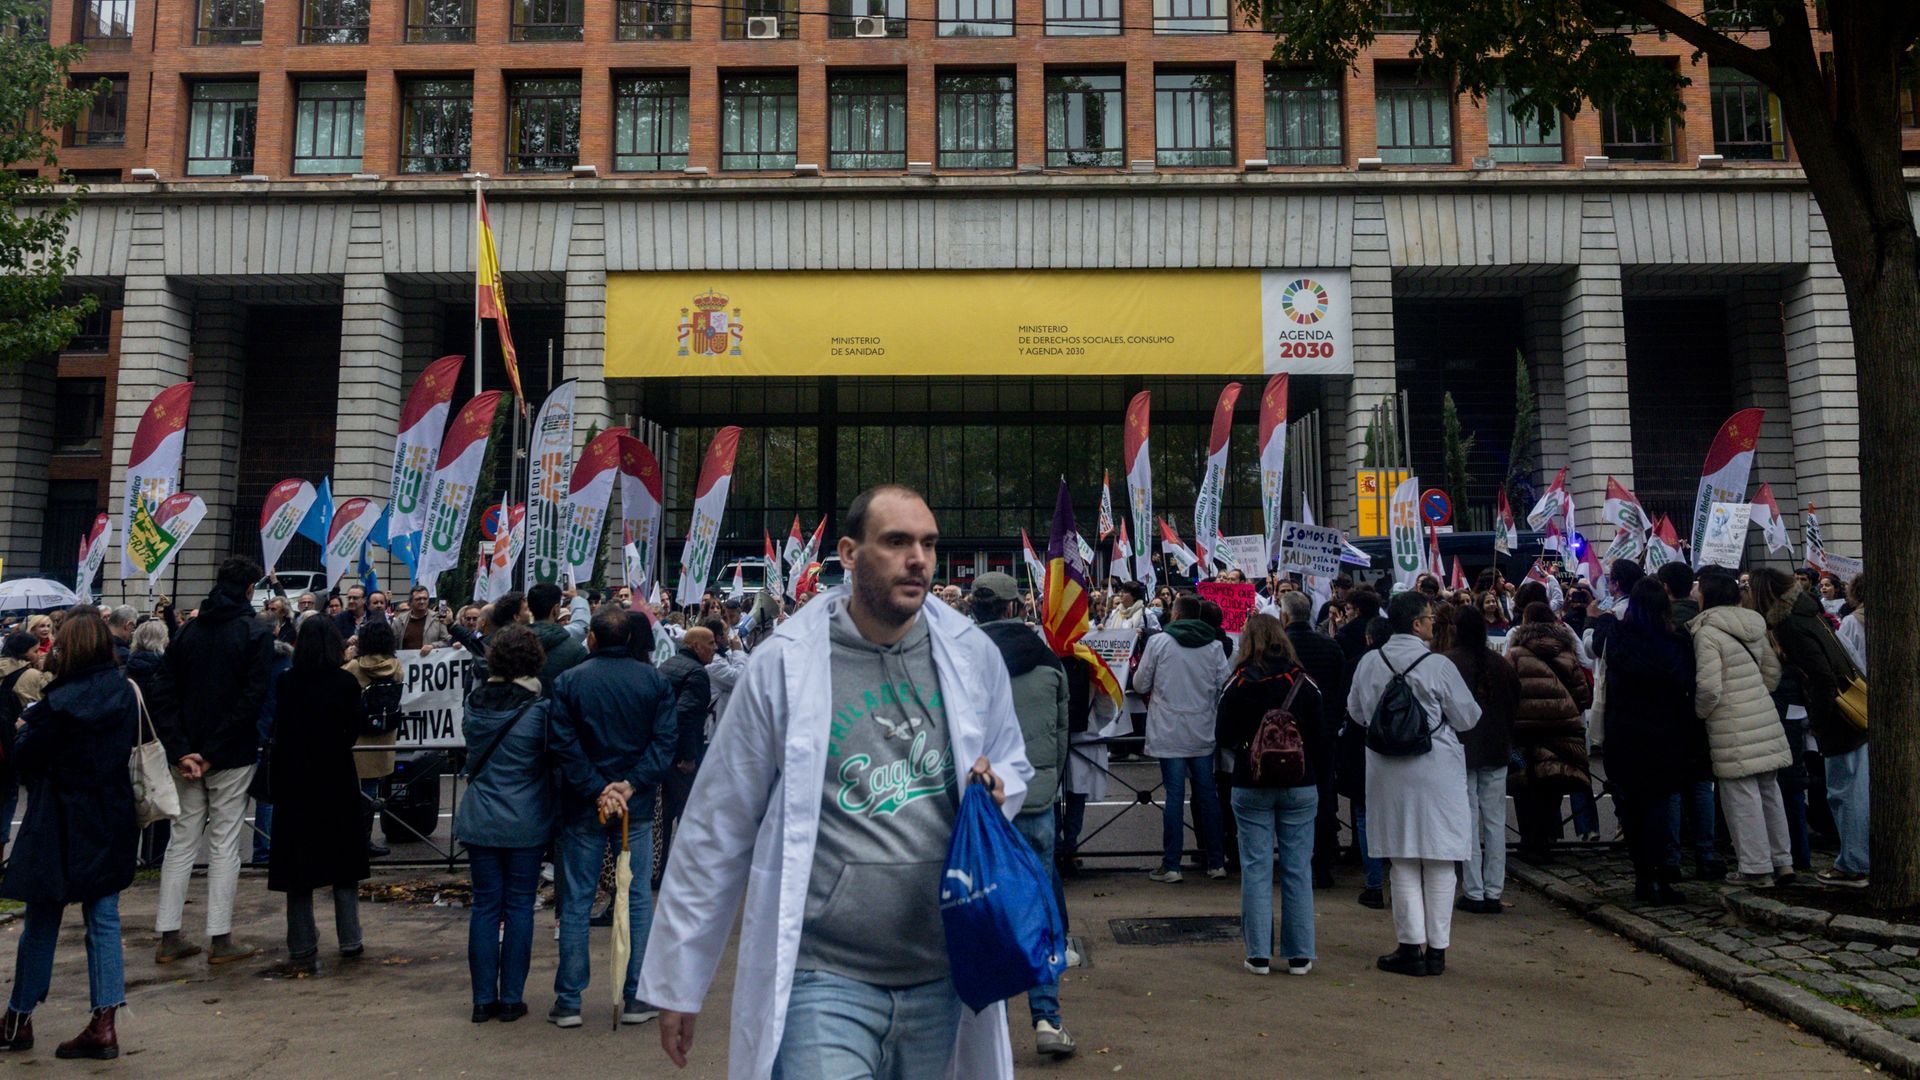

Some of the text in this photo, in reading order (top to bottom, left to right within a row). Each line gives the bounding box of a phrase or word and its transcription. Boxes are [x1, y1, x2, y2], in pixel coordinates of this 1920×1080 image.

[831, 337, 881, 345] MINISTERIO
[1018, 325, 1069, 334] MINISTERIO
[1018, 335, 1175, 346] DE DERECHOS SOCIALES, CONSUMO
[1279, 330, 1335, 341] AGENDA
[831, 347, 885, 356] DE SANIDAD
[1018, 347, 1085, 356] Y AGENDA 2030
[1280, 342, 1335, 359] 2030
[130, 476, 142, 506] Médico
[390, 443, 408, 517] Sindicato Médico
[398, 447, 429, 513] CESM
[560, 454, 571, 500] Mancha
[421, 479, 446, 554] Sindicato Médico
[433, 483, 466, 551] CESM
[528, 460, 541, 581] SINDICATO MÉDICO
[535, 452, 562, 585] CESM
[567, 506, 597, 565] CESM
[1209, 498, 1218, 538] Sindicato
[1286, 526, 1340, 545] SOMOS EL
[1695, 484, 1713, 552] Sindicato Médico
[693, 514, 715, 583] CESM
[1321, 546, 1333, 554] TU
[1394, 503, 1419, 571] CESM
[1282, 549, 1312, 566] SALUD
[1078, 638, 1131, 649] SINDICATO MÉDICO
[836, 730, 957, 815] Eagles
